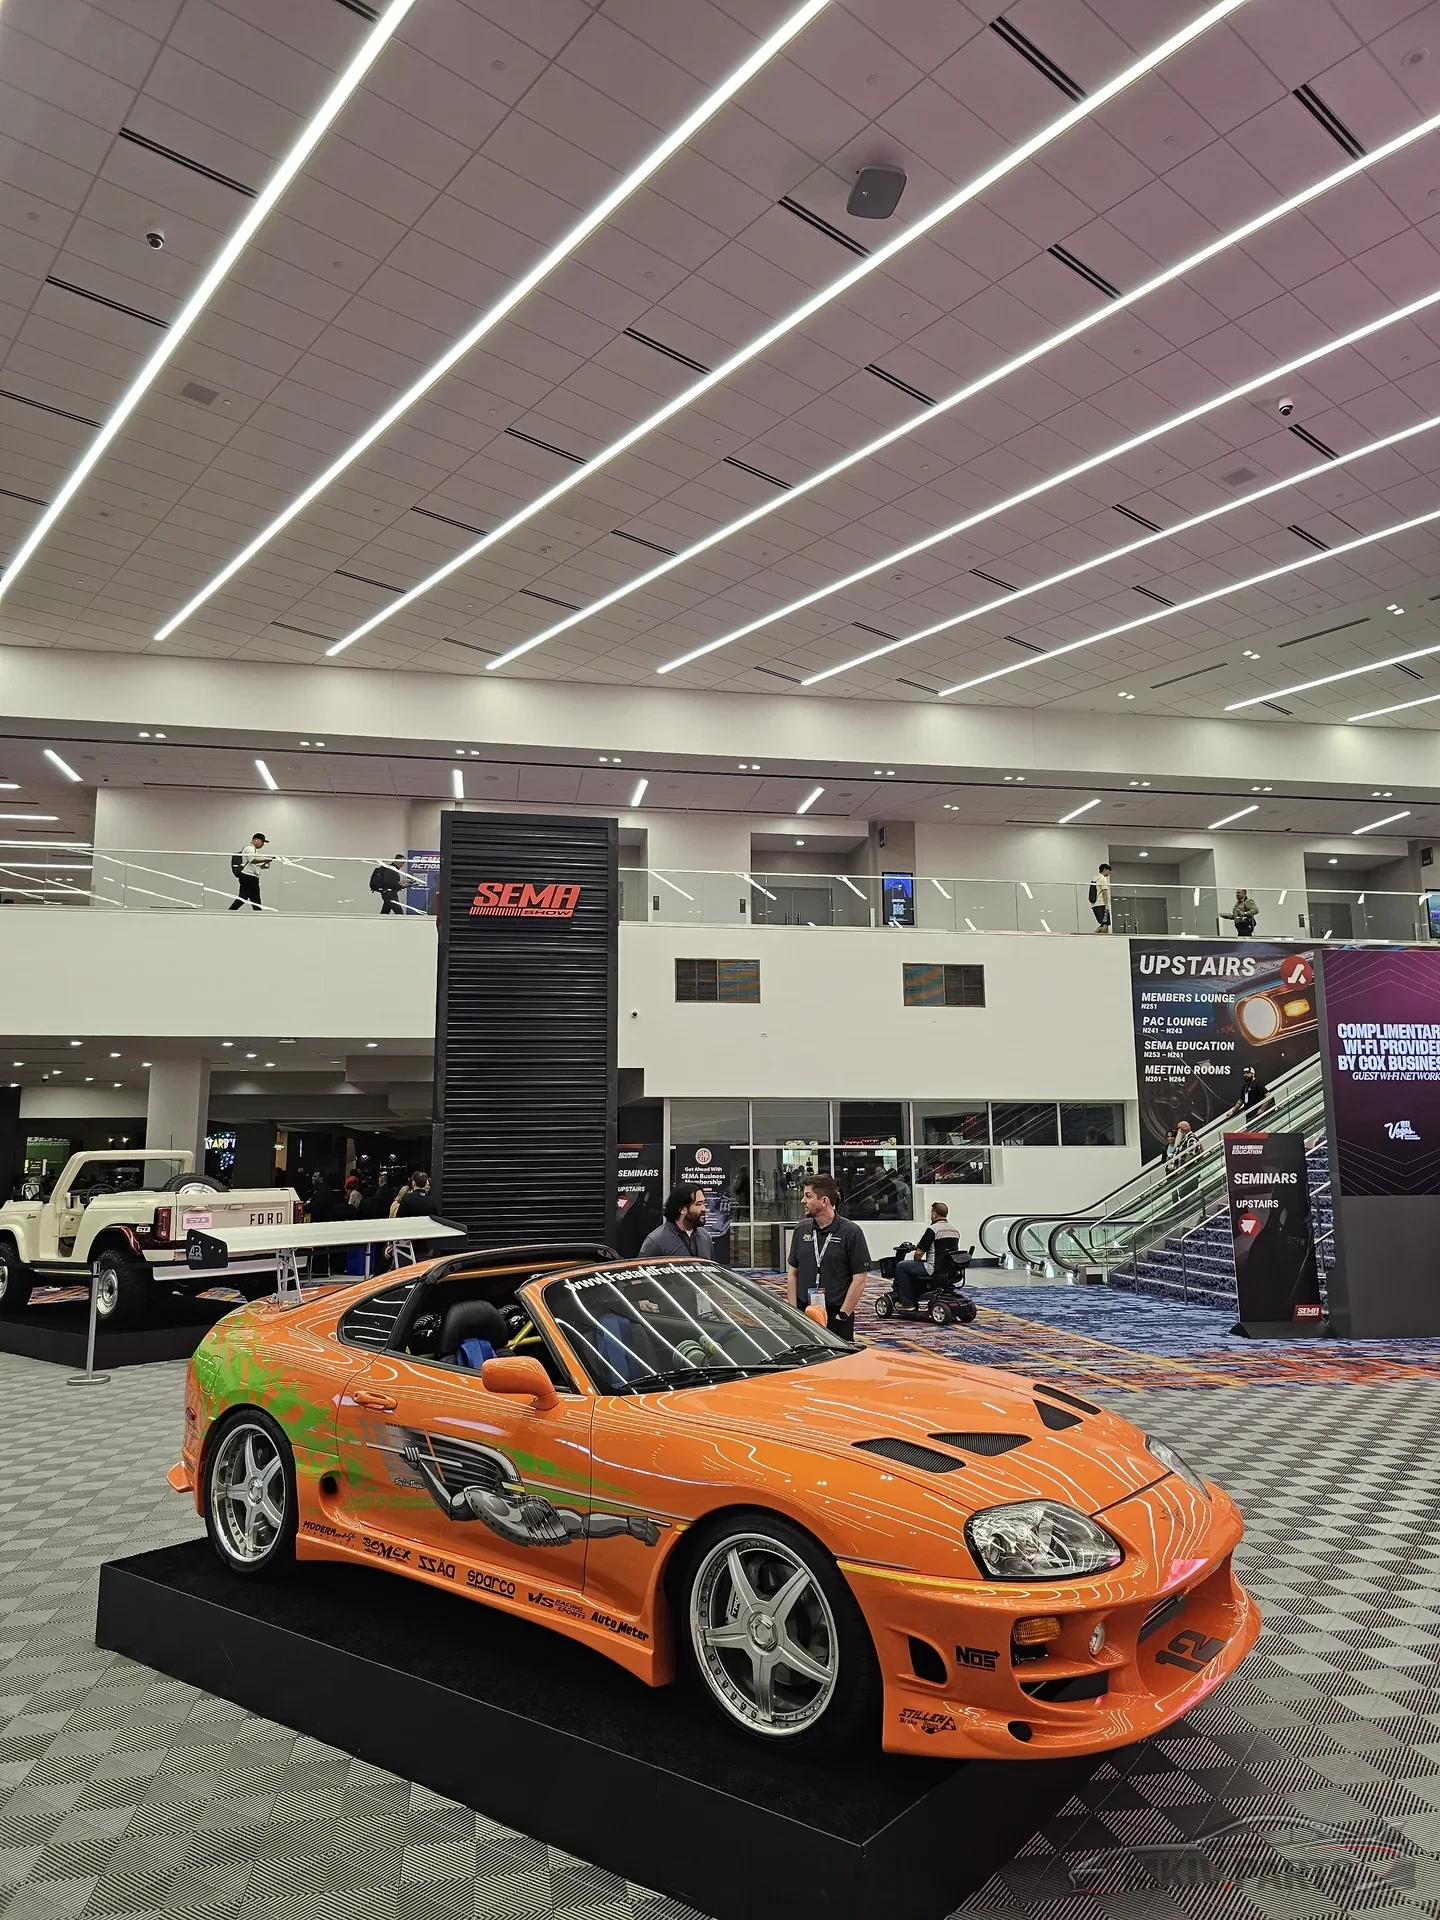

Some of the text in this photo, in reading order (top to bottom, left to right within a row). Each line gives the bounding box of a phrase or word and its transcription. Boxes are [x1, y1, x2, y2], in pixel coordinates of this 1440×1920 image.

[472, 882, 581, 909] SEMA
[523, 909, 571, 917] SHOW
[1139, 954, 1256, 977] UPSTAIRS
[1141, 993, 1236, 1003] MEMBERS LOUNGE
[1143, 1016, 1208, 1027] PAC LOUNGE
[1144, 1040, 1235, 1051] SEMA EDUCATION
[1342, 1039, 1379, 1055] WI-FI
[1145, 1065, 1231, 1075] MEETING ROOMS
[1337, 1055, 1357, 1071] BY
[1358, 1055, 1387, 1071] COX
[1352, 1071, 1380, 1081] GUEST
[617, 1169, 659, 1177] SEMINARS
[1233, 1172, 1298, 1185] SEMINARS
[1236, 1199, 1279, 1209] UPSTAIRS
[250, 1212, 283, 1226] FORD
[1297, 1307, 1320, 1316] SEMA
[467, 1569, 516, 1596] sparco
[555, 1598, 584, 1612] RACING
[557, 1606, 587, 1620] SPORTS
[955, 1644, 998, 1669] NOS
[1155, 1629, 1229, 1673] 12
[899, 1707, 949, 1724] STILLEN
